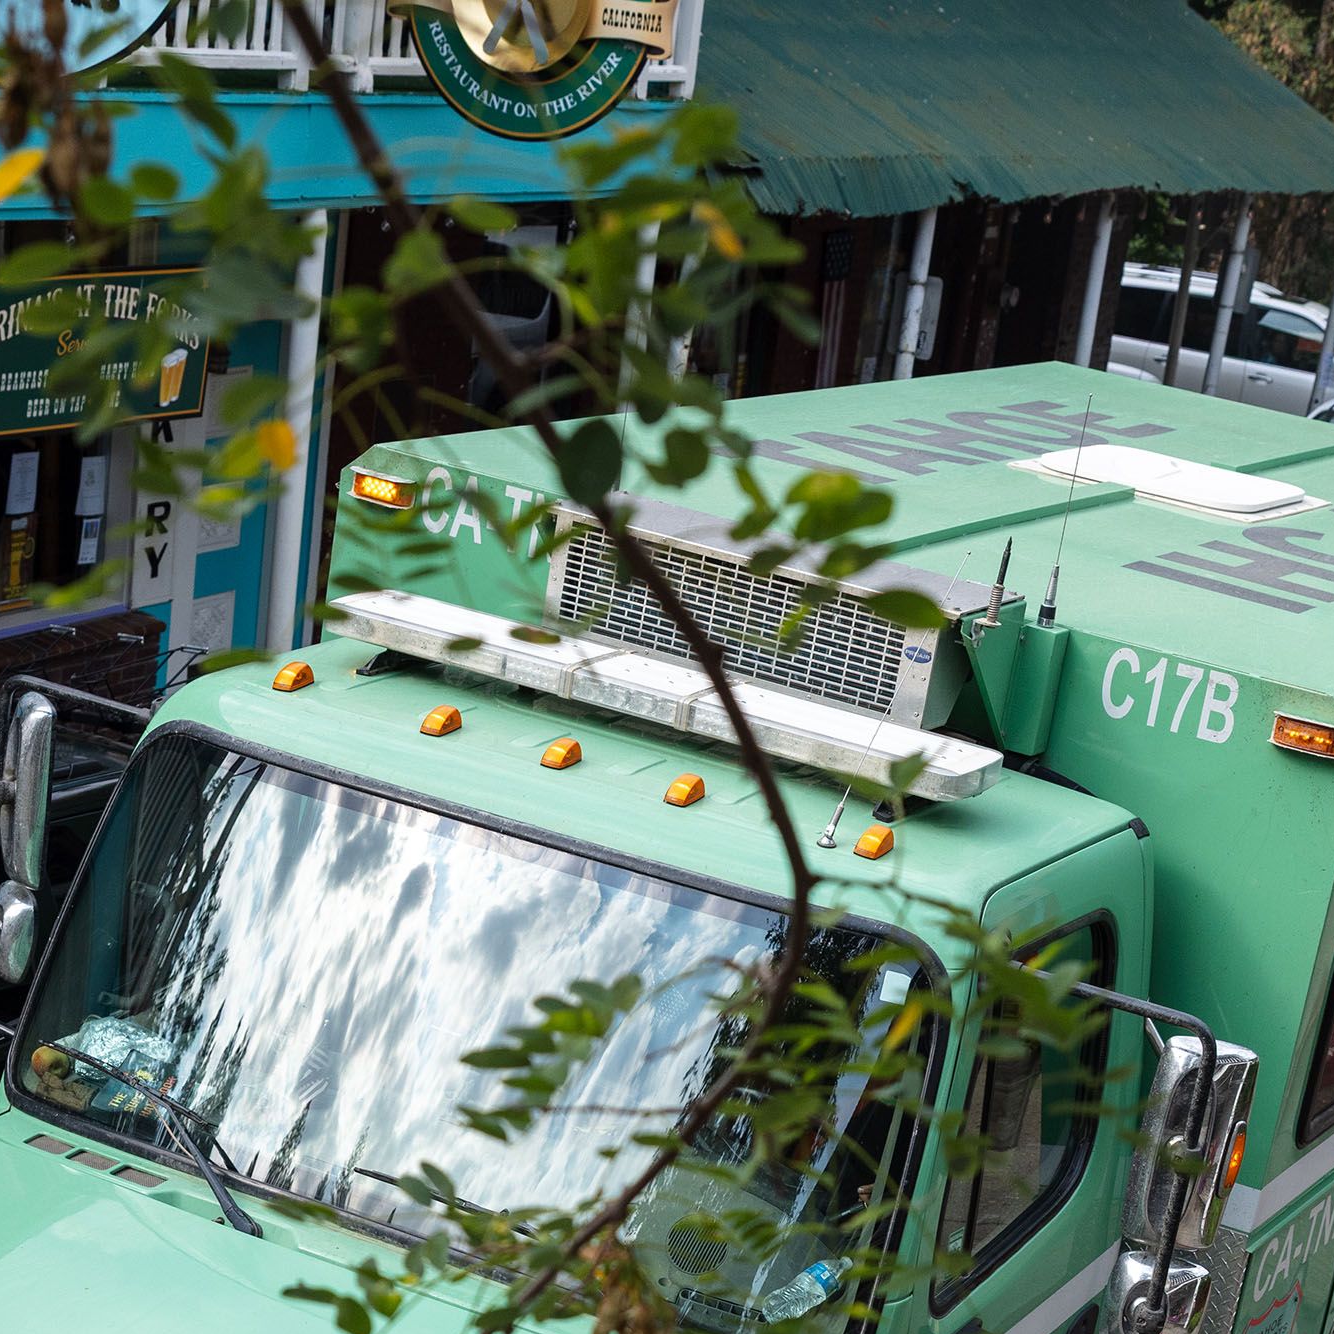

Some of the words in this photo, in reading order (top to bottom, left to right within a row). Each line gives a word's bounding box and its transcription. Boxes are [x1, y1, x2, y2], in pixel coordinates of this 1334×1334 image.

[601, 7, 663, 33] CALIFORNIA
[429, 19, 514, 118] RESTAURANT
[513, 101, 539, 119] ON
[540, 96, 578, 118] THE
[579, 50, 623, 101] RIVER
[103, 284, 141, 321] THE
[99, 361, 130, 381] HAPPY
[26, 397, 51, 418] BEER
[54, 398, 68, 416] ON
[711, 399, 1176, 485] TAHOE
[1102, 647, 1240, 745] C17B
[108, 1090, 128, 1108] THE
